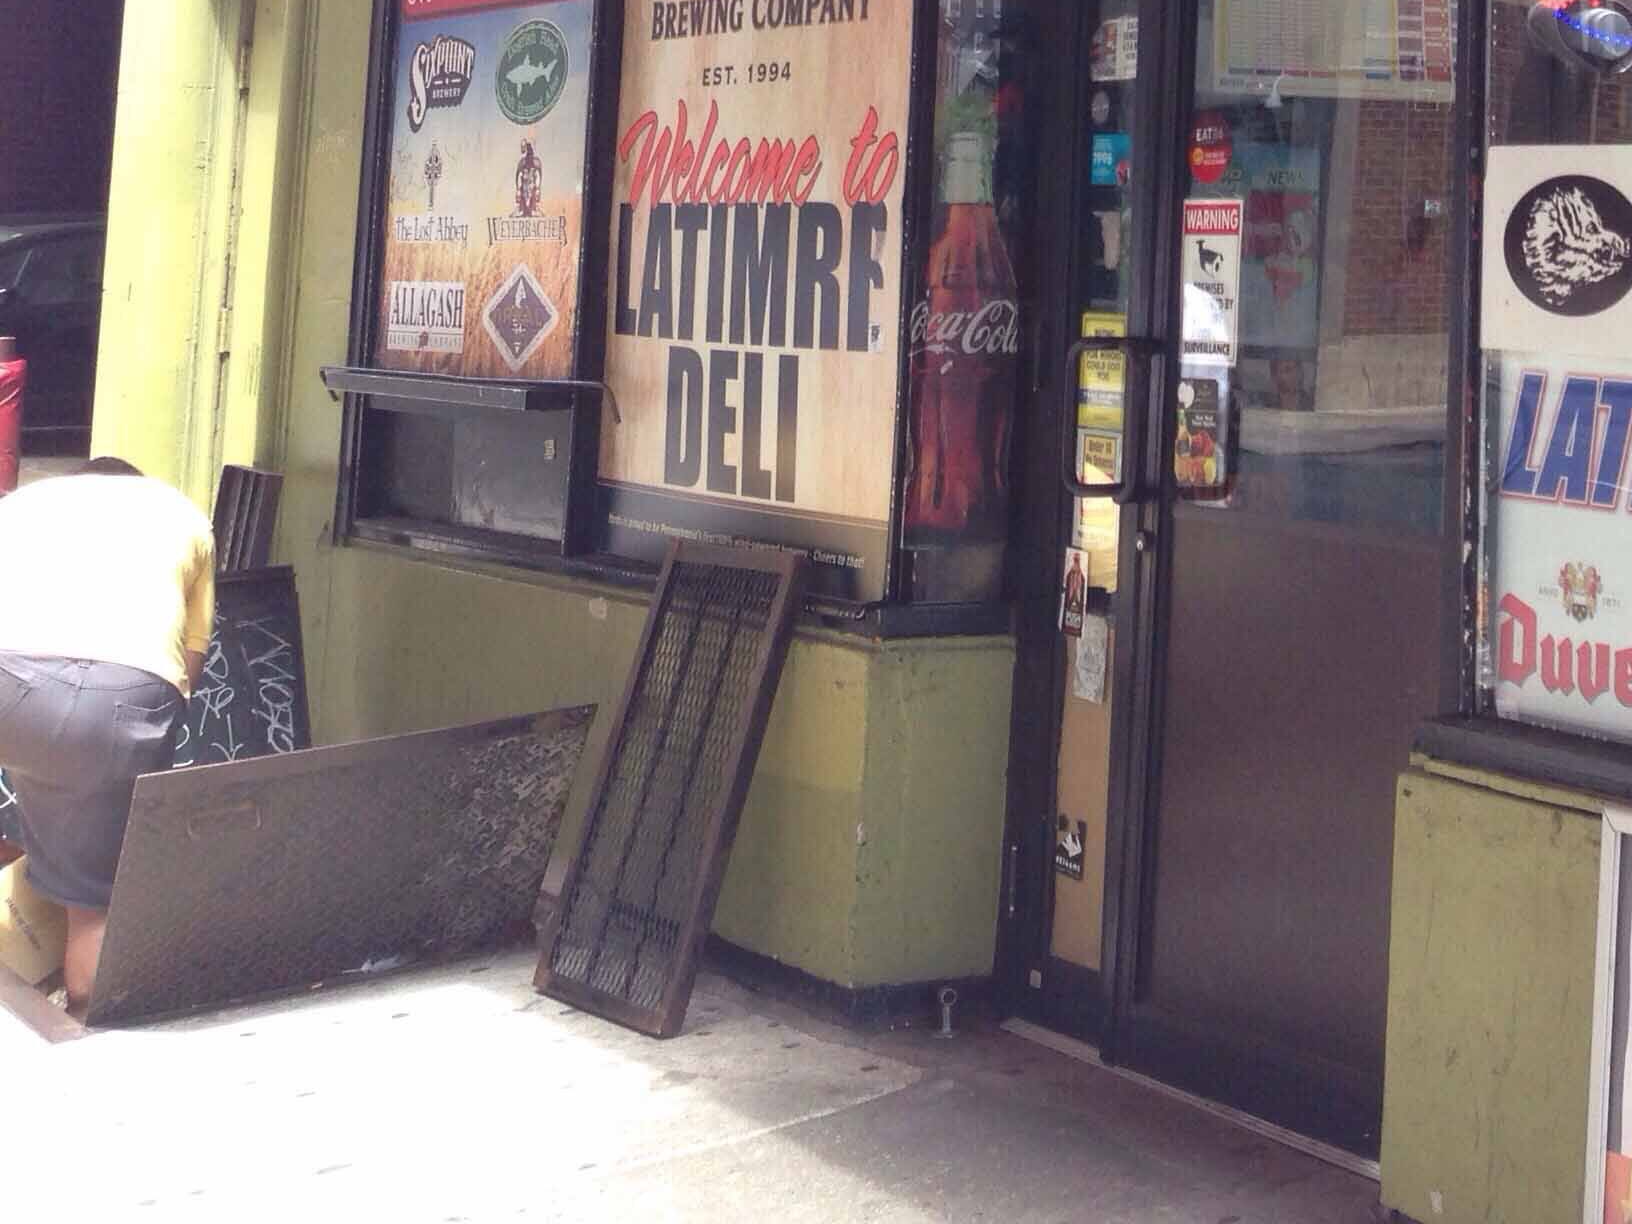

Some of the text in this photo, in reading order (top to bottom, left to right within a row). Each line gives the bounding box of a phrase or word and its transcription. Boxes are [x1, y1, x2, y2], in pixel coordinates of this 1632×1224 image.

[702, 62, 792, 87] EST. 1994
[619, 99, 899, 209] Welcome to
[1186, 209, 1239, 232] WARNING
[390, 286, 465, 329] ALLAGASH
[663, 345, 799, 503] DELI
